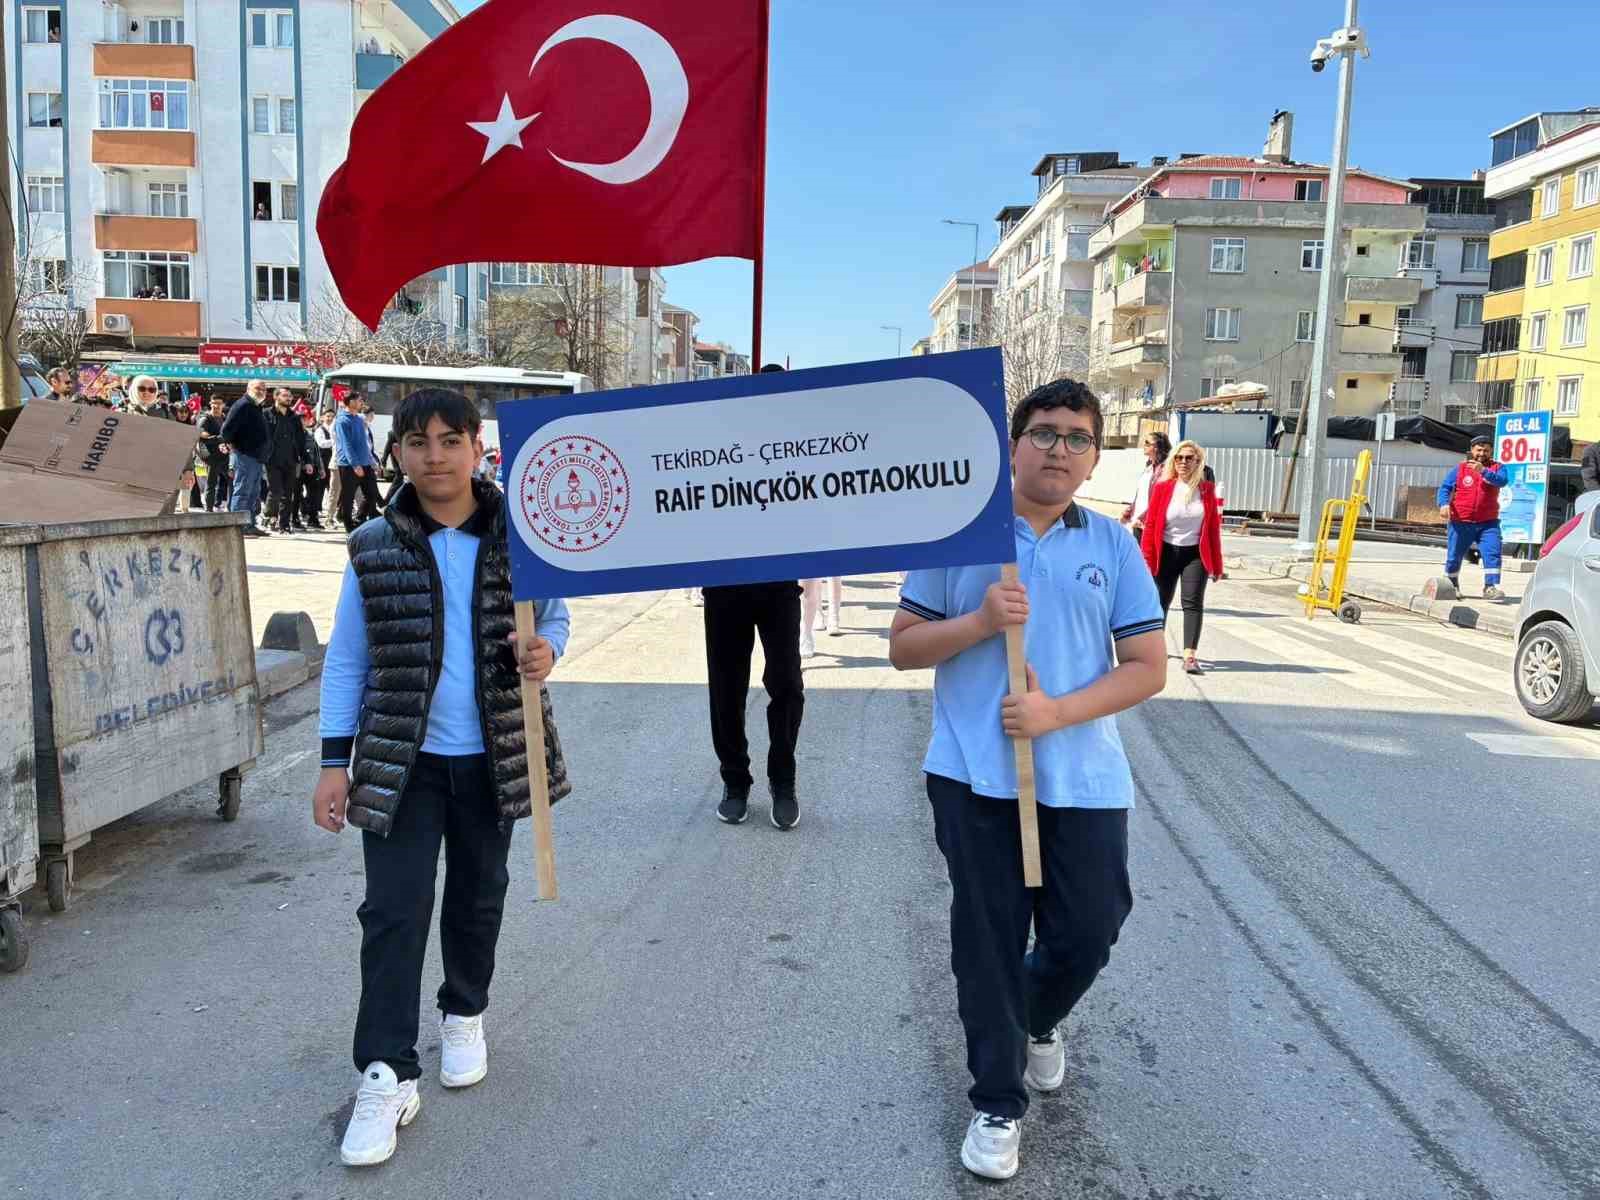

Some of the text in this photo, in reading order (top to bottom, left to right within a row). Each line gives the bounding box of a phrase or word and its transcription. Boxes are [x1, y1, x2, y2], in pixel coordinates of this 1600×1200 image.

[222, 356, 315, 368] MARKE
[1505, 417, 1541, 432] GEL-AL
[81, 417, 119, 471] HARIBO
[651, 443, 743, 471] TEKİRDAĞ
[759, 431, 869, 465] ÇERKEZKÖY
[1501, 438, 1541, 463] 80 TL
[655, 459, 971, 513] RAİF DİNÇKÖK ORTAOKULU
